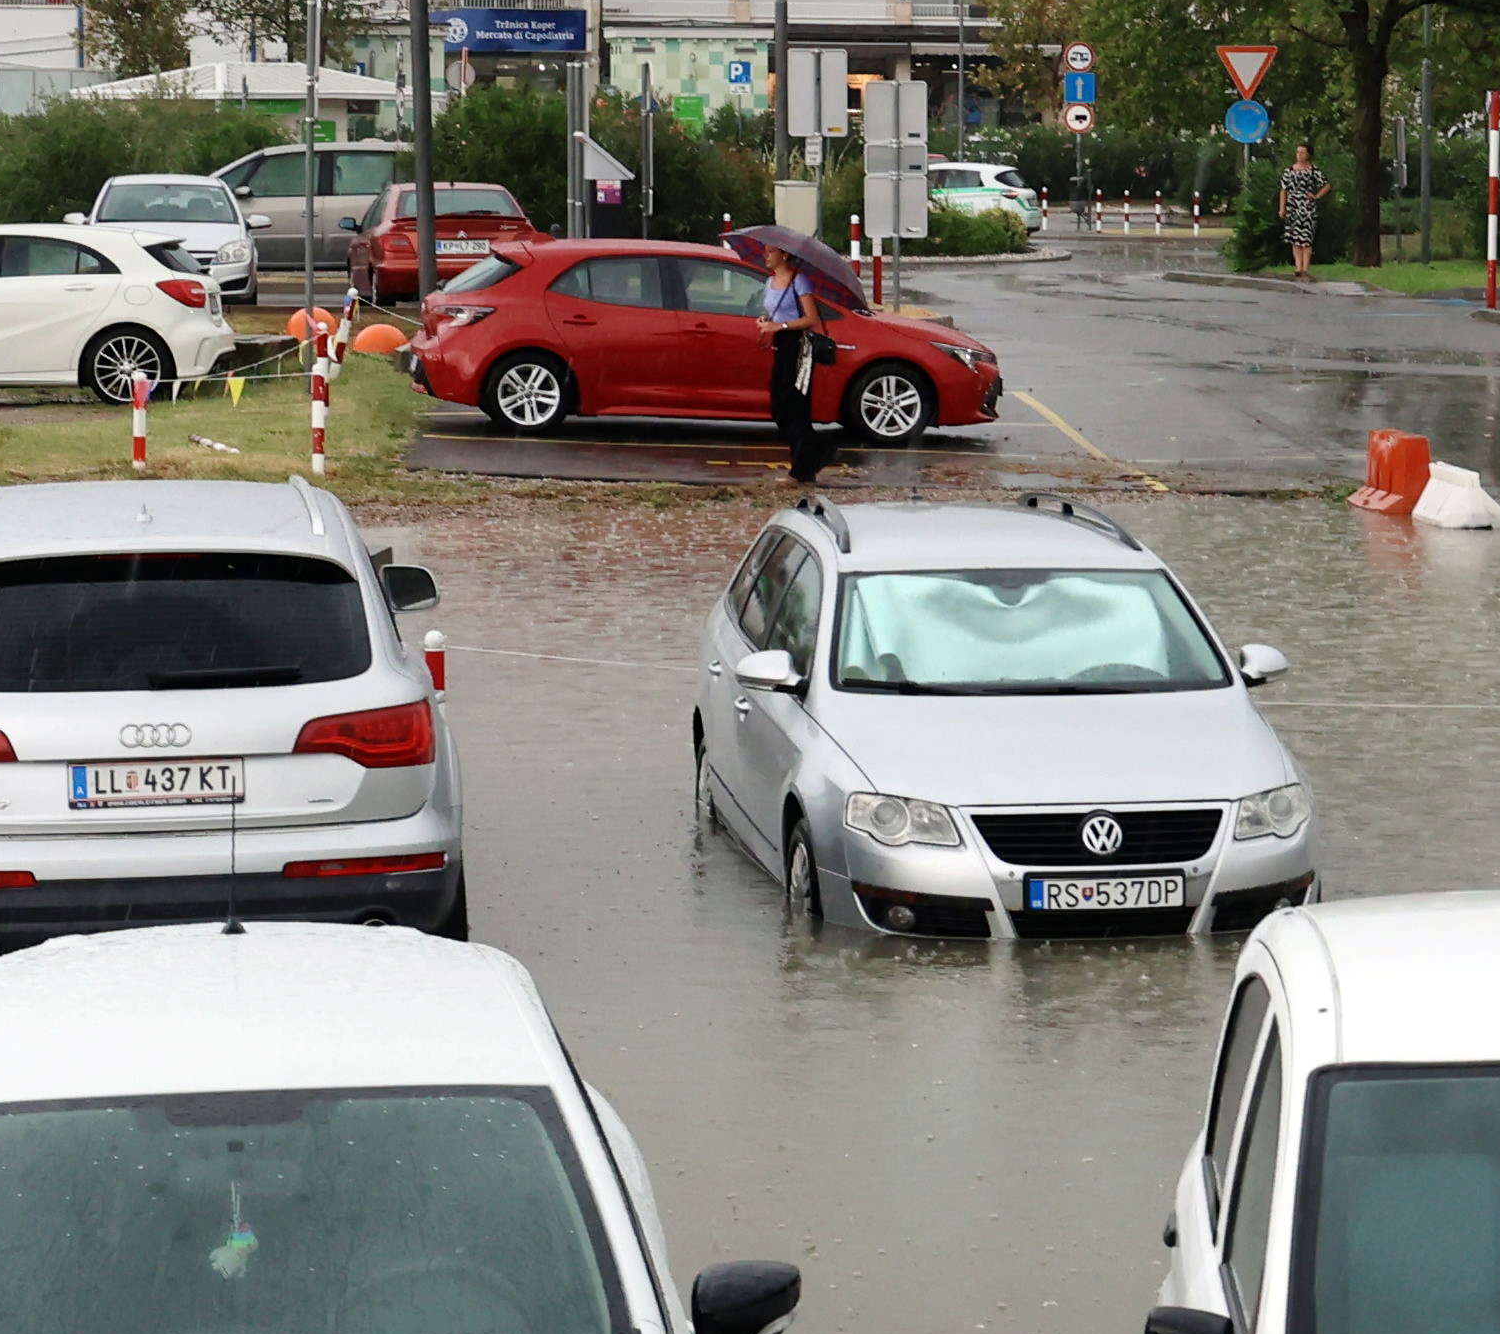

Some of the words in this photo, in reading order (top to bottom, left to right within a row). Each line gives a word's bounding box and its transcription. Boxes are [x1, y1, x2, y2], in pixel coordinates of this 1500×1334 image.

[494, 20, 529, 29] Tržnica
[531, 20, 556, 31] Koper
[475, 31, 512, 40] Mercato
[514, 30, 523, 40] di
[524, 31, 575, 42] Capodistria
[730, 63, 743, 80] P
[443, 241, 456, 251] KP
[76, 786, 84, 795] A
[94, 769, 122, 794] LL
[143, 767, 191, 793] 437
[199, 765, 230, 791] KT
[1048, 883, 1080, 909] RS
[1096, 879, 1179, 906] 537DP
